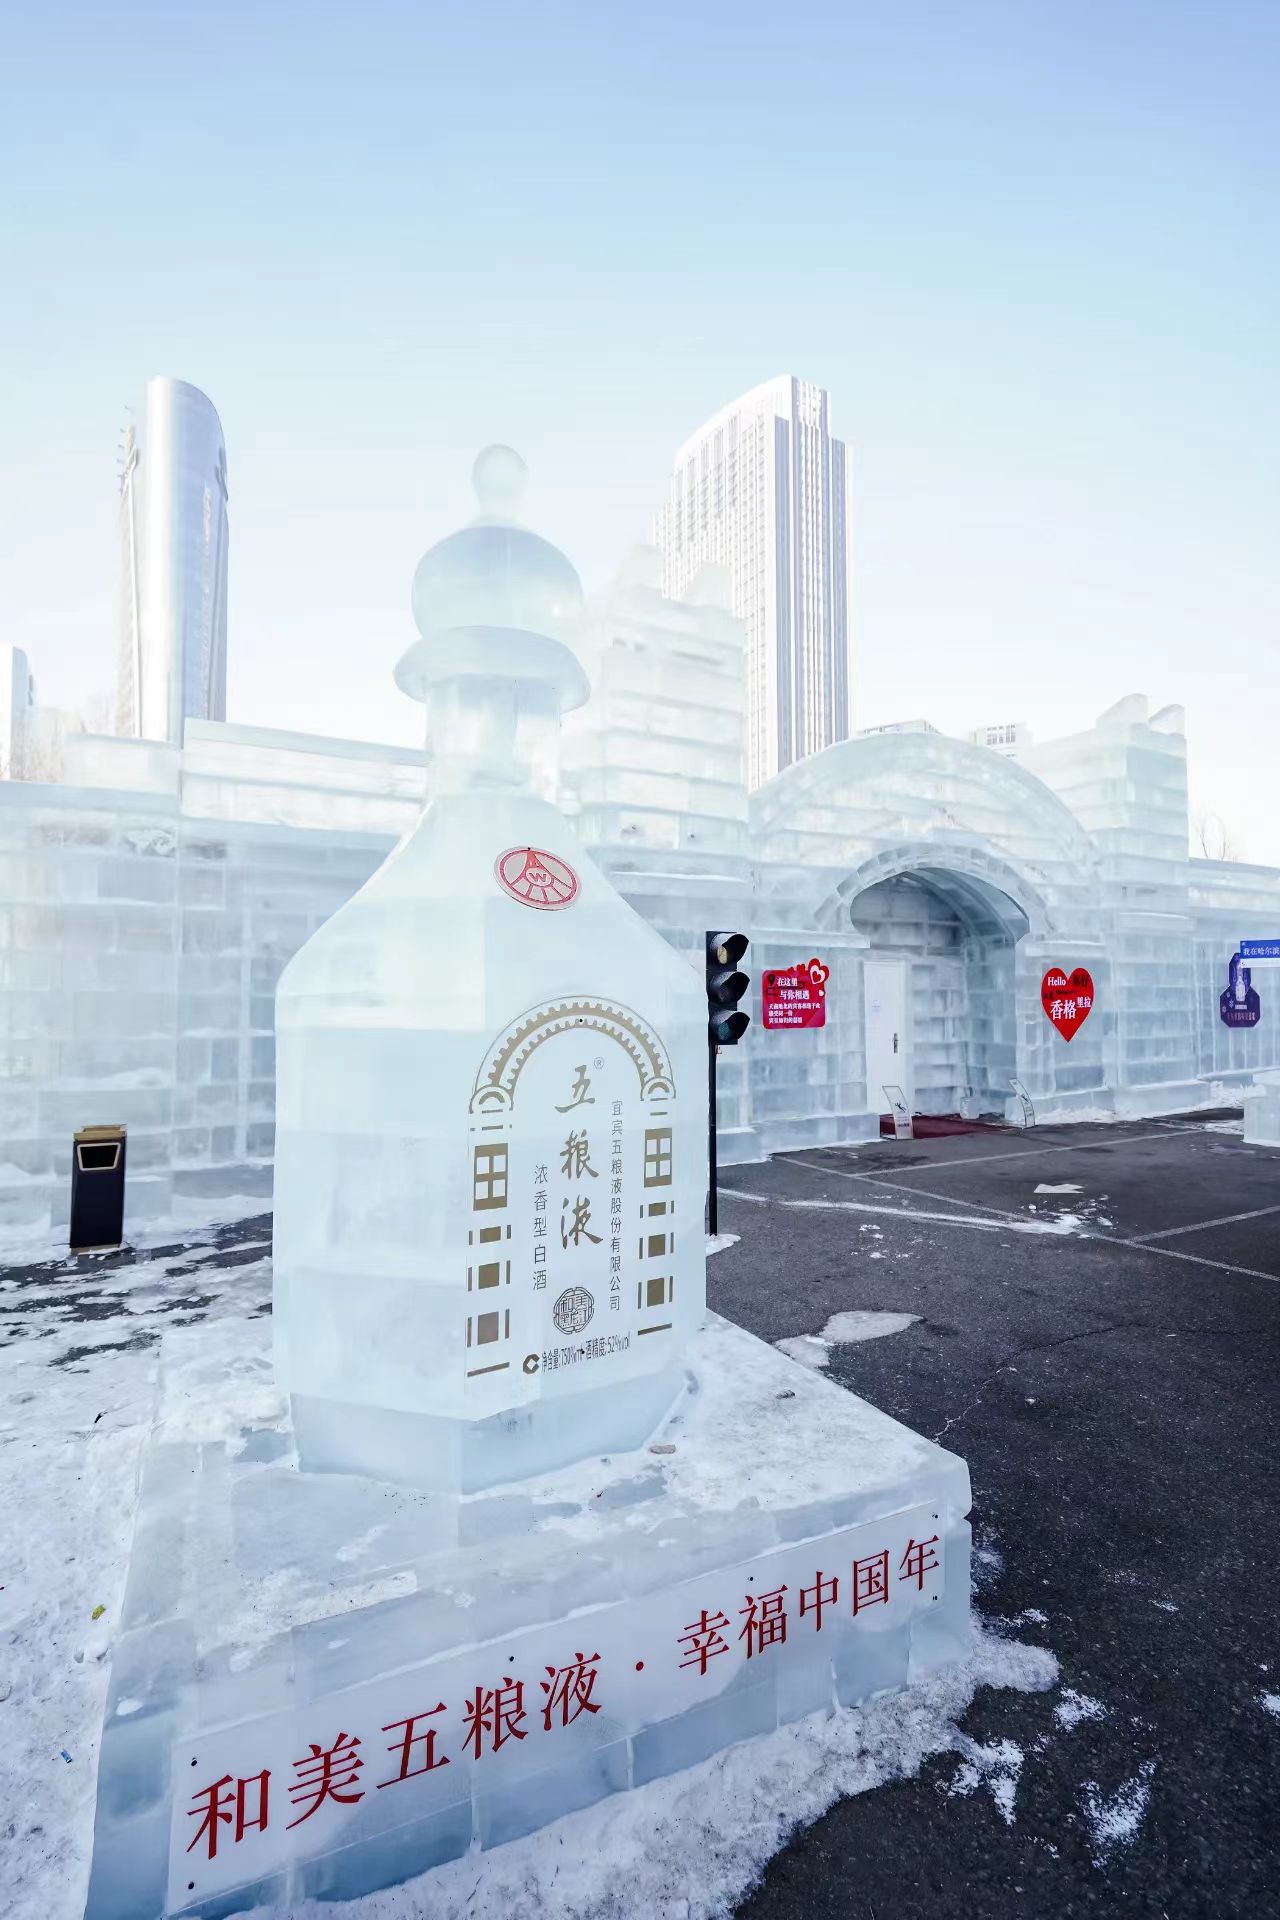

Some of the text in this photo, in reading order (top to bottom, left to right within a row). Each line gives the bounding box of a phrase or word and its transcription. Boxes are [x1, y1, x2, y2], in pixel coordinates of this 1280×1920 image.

[779, 989, 810, 1000] 与你相遇
[1047, 976, 1067, 986] Hello
[554, 1064, 604, 1250] 五粮液
[609, 1100, 623, 1312] 宜宾五粮液股份有限公司
[533, 1164, 548, 1291] 浓香型白酒
